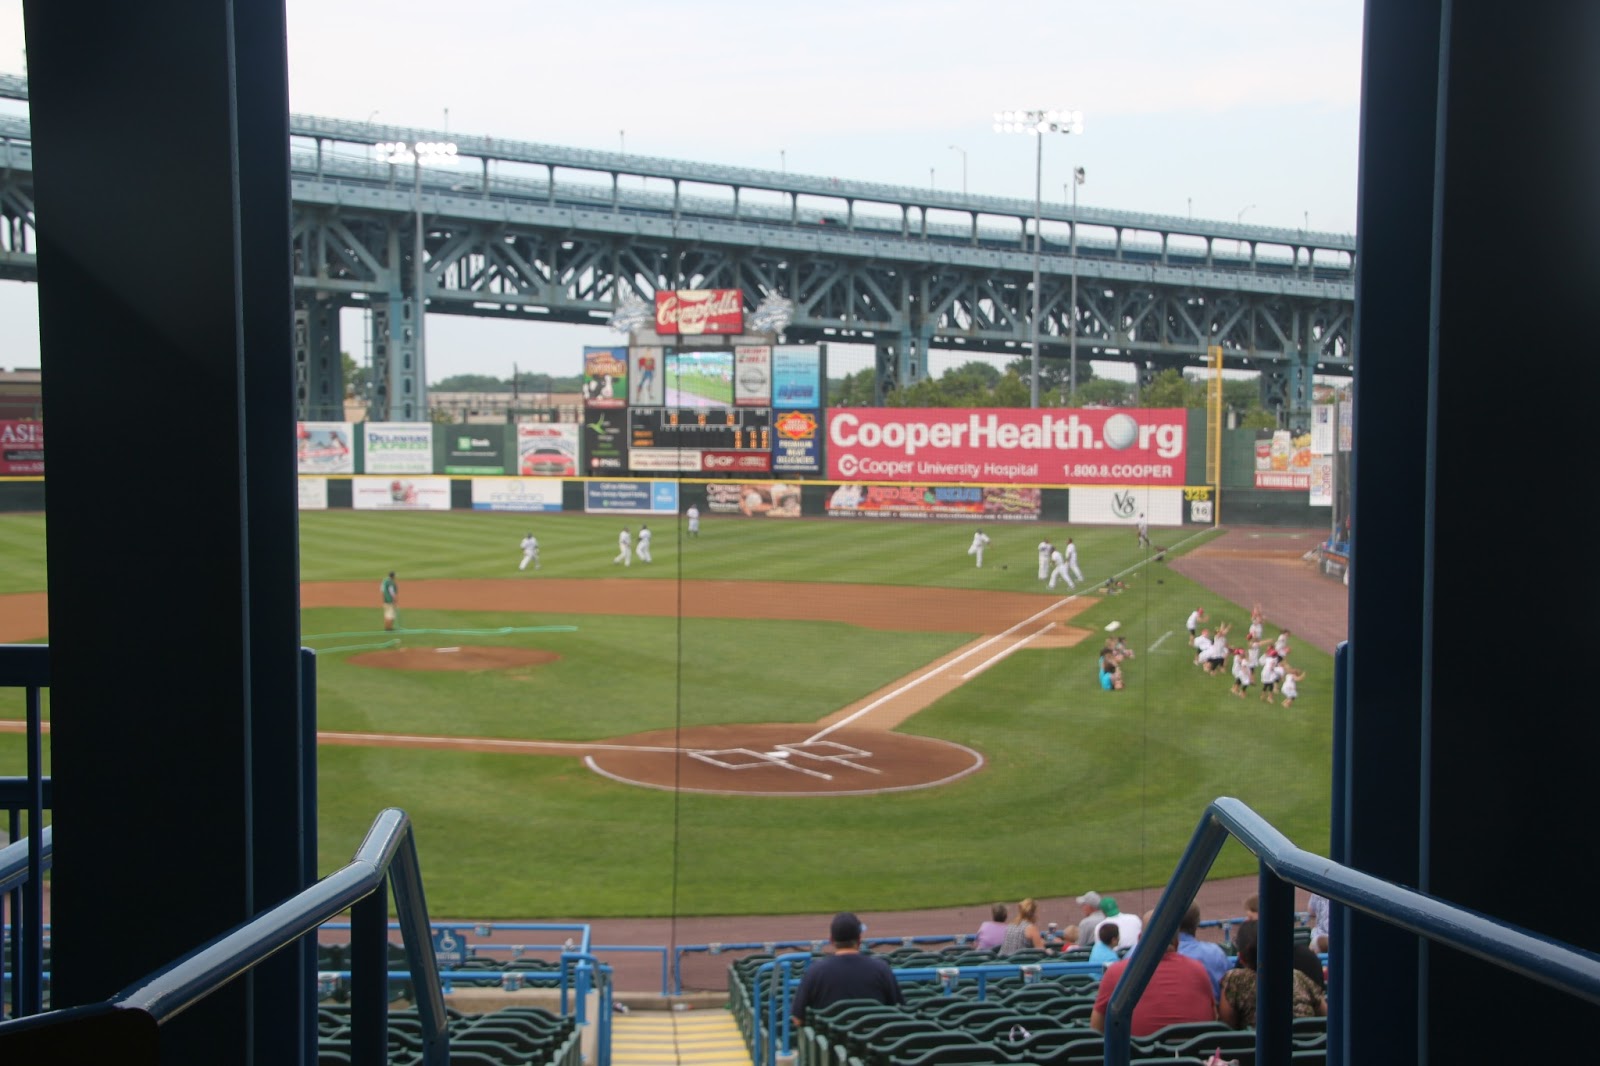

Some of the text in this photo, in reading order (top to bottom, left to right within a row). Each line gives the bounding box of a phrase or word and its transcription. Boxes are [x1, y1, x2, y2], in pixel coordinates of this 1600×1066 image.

[657, 291, 740, 325] Campbell's
[858, 457, 1038, 478] Cooper University Hospital
[1114, 489, 1135, 514] V8
[1184, 487, 1210, 501] 325
